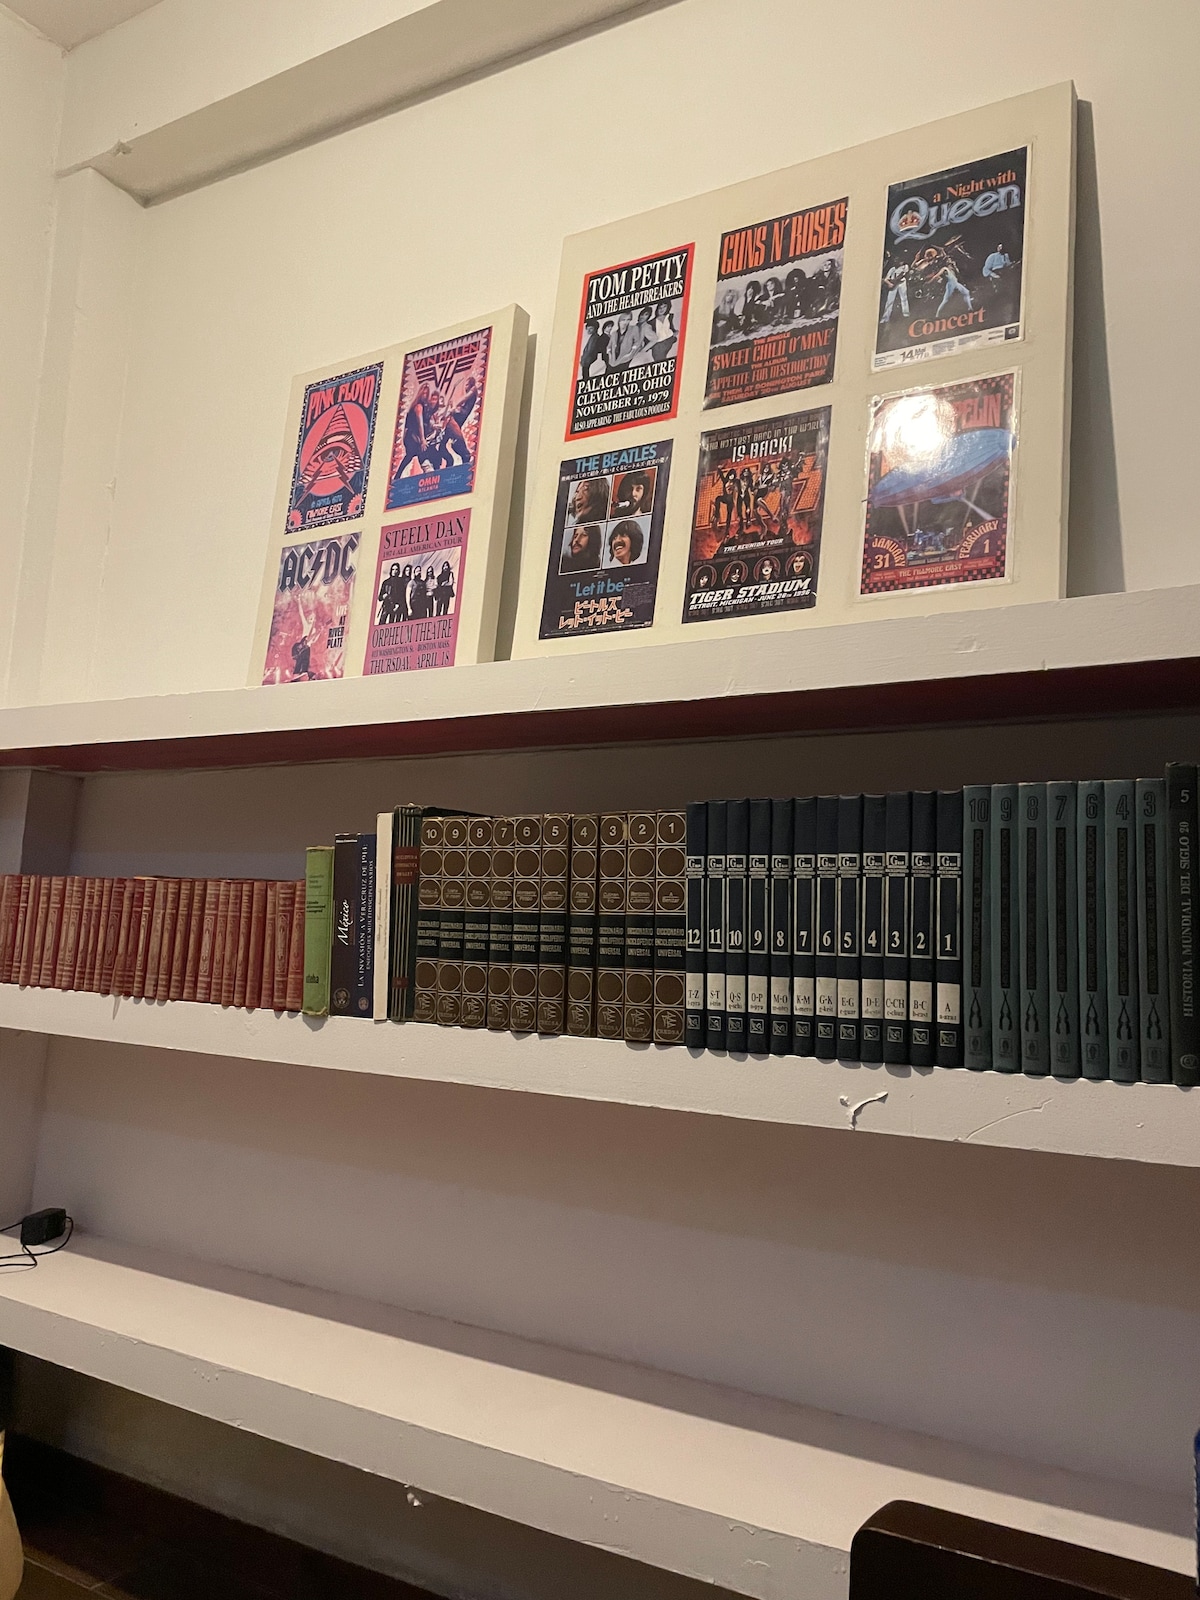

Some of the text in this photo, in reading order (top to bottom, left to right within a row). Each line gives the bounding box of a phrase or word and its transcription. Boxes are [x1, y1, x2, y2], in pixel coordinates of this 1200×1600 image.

[933, 169, 1017, 203] a Night with
[890, 184, 1021, 245] Queen
[720, 225, 767, 276] GUNS
[789, 202, 846, 257] ROSES
[589, 252, 687, 303] TOM PETTY
[586, 280, 684, 319] AND THE HEARTBREAKERS
[908, 305, 986, 338] Concert
[413, 340, 480, 371] VAN HALEN
[752, 340, 786, 362] CHILD
[900, 349, 914, 362] 14
[577, 359, 675, 394] PALACE THEATRE
[752, 367, 768, 382] FOR
[577, 375, 671, 406] CLEVELAND, OHIO
[744, 385, 754, 393] AT
[306, 386, 336, 428] PINK
[338, 374, 375, 408] FLOYD
[576, 397, 631, 418] NOVEMBER
[648, 390, 669, 402] 1979
[574, 402, 670, 432] ALSO APPEARING THE FABULOUS POODLES
[732, 435, 793, 462] IS BACK!
[575, 456, 600, 473] THE
[602, 445, 657, 468] BEATLES
[418, 475, 440, 486] OMNI
[418, 484, 438, 493] ATLANTA
[384, 516, 466, 549] STEELY DAN
[959, 519, 999, 559] FEBRUARY
[410, 541, 442, 553] AMERICAN
[444, 537, 463, 546] TOUR
[737, 541, 765, 551] REUNION
[766, 538, 784, 546] TOUR
[872, 537, 906, 567] JANUARY
[983, 539, 990, 554] 1
[278, 535, 358, 592] AC/DC
[873, 553, 890, 569] 31
[900, 569, 912, 577] THE
[913, 566, 944, 575] FILLMORE
[945, 562, 962, 571] EAST
[596, 580, 605, 594] it
[689, 577, 812, 605] TIGER STADIUM
[574, 596, 622, 615] ビートルズ
[719, 597, 753, 607] MICHIGAN
[757, 594, 776, 602] JUNE
[336, 605, 348, 616] LIVE
[339, 615, 346, 626] AT
[329, 627, 345, 638] RIVER
[372, 619, 453, 648] ORPHEUM THEATRE
[327, 637, 343, 649] PLATE
[415, 651, 450, 669] APRIL 18
[1143, 791, 1156, 817] 3
[1181, 789, 1190, 803] 5
[969, 797, 989, 822] 10
[1000, 797, 1012, 821] 9
[1026, 796, 1038, 820] 8
[1055, 795, 1067, 821] 7
[1086, 794, 1098, 819] 6
[1116, 794, 1130, 820] 4
[426, 829, 437, 839] 10
[452, 829, 459, 839] 9
[476, 828, 484, 838] 8
[501, 827, 507, 838] 7
[523, 826, 531, 837] 6
[551, 826, 559, 836] 5
[580, 827, 588, 837] 4
[609, 825, 617, 836] 3
[639, 824, 646, 835] 2
[669, 822, 675, 834] 1
[362, 867, 368, 877] DE
[360, 879, 368, 922] VERACRUZ
[337, 899, 354, 946] México
[1179, 821, 1194, 1017] HISTORIA MUNDIAL DEL SIGLO 20
[688, 928, 700, 944] 12
[710, 928, 721, 944] 11
[729, 929, 742, 946] 10
[754, 930, 762, 946] 9
[776, 930, 784, 947] 8
[799, 930, 808, 947] 7
[822, 930, 832, 947] 6
[843, 931, 852, 948] 5
[867, 930, 877, 948] 4
[891, 931, 900, 948] 3
[916, 932, 925, 949] 2
[944, 934, 952, 951] 1
[945, 1003, 951, 1012] A
